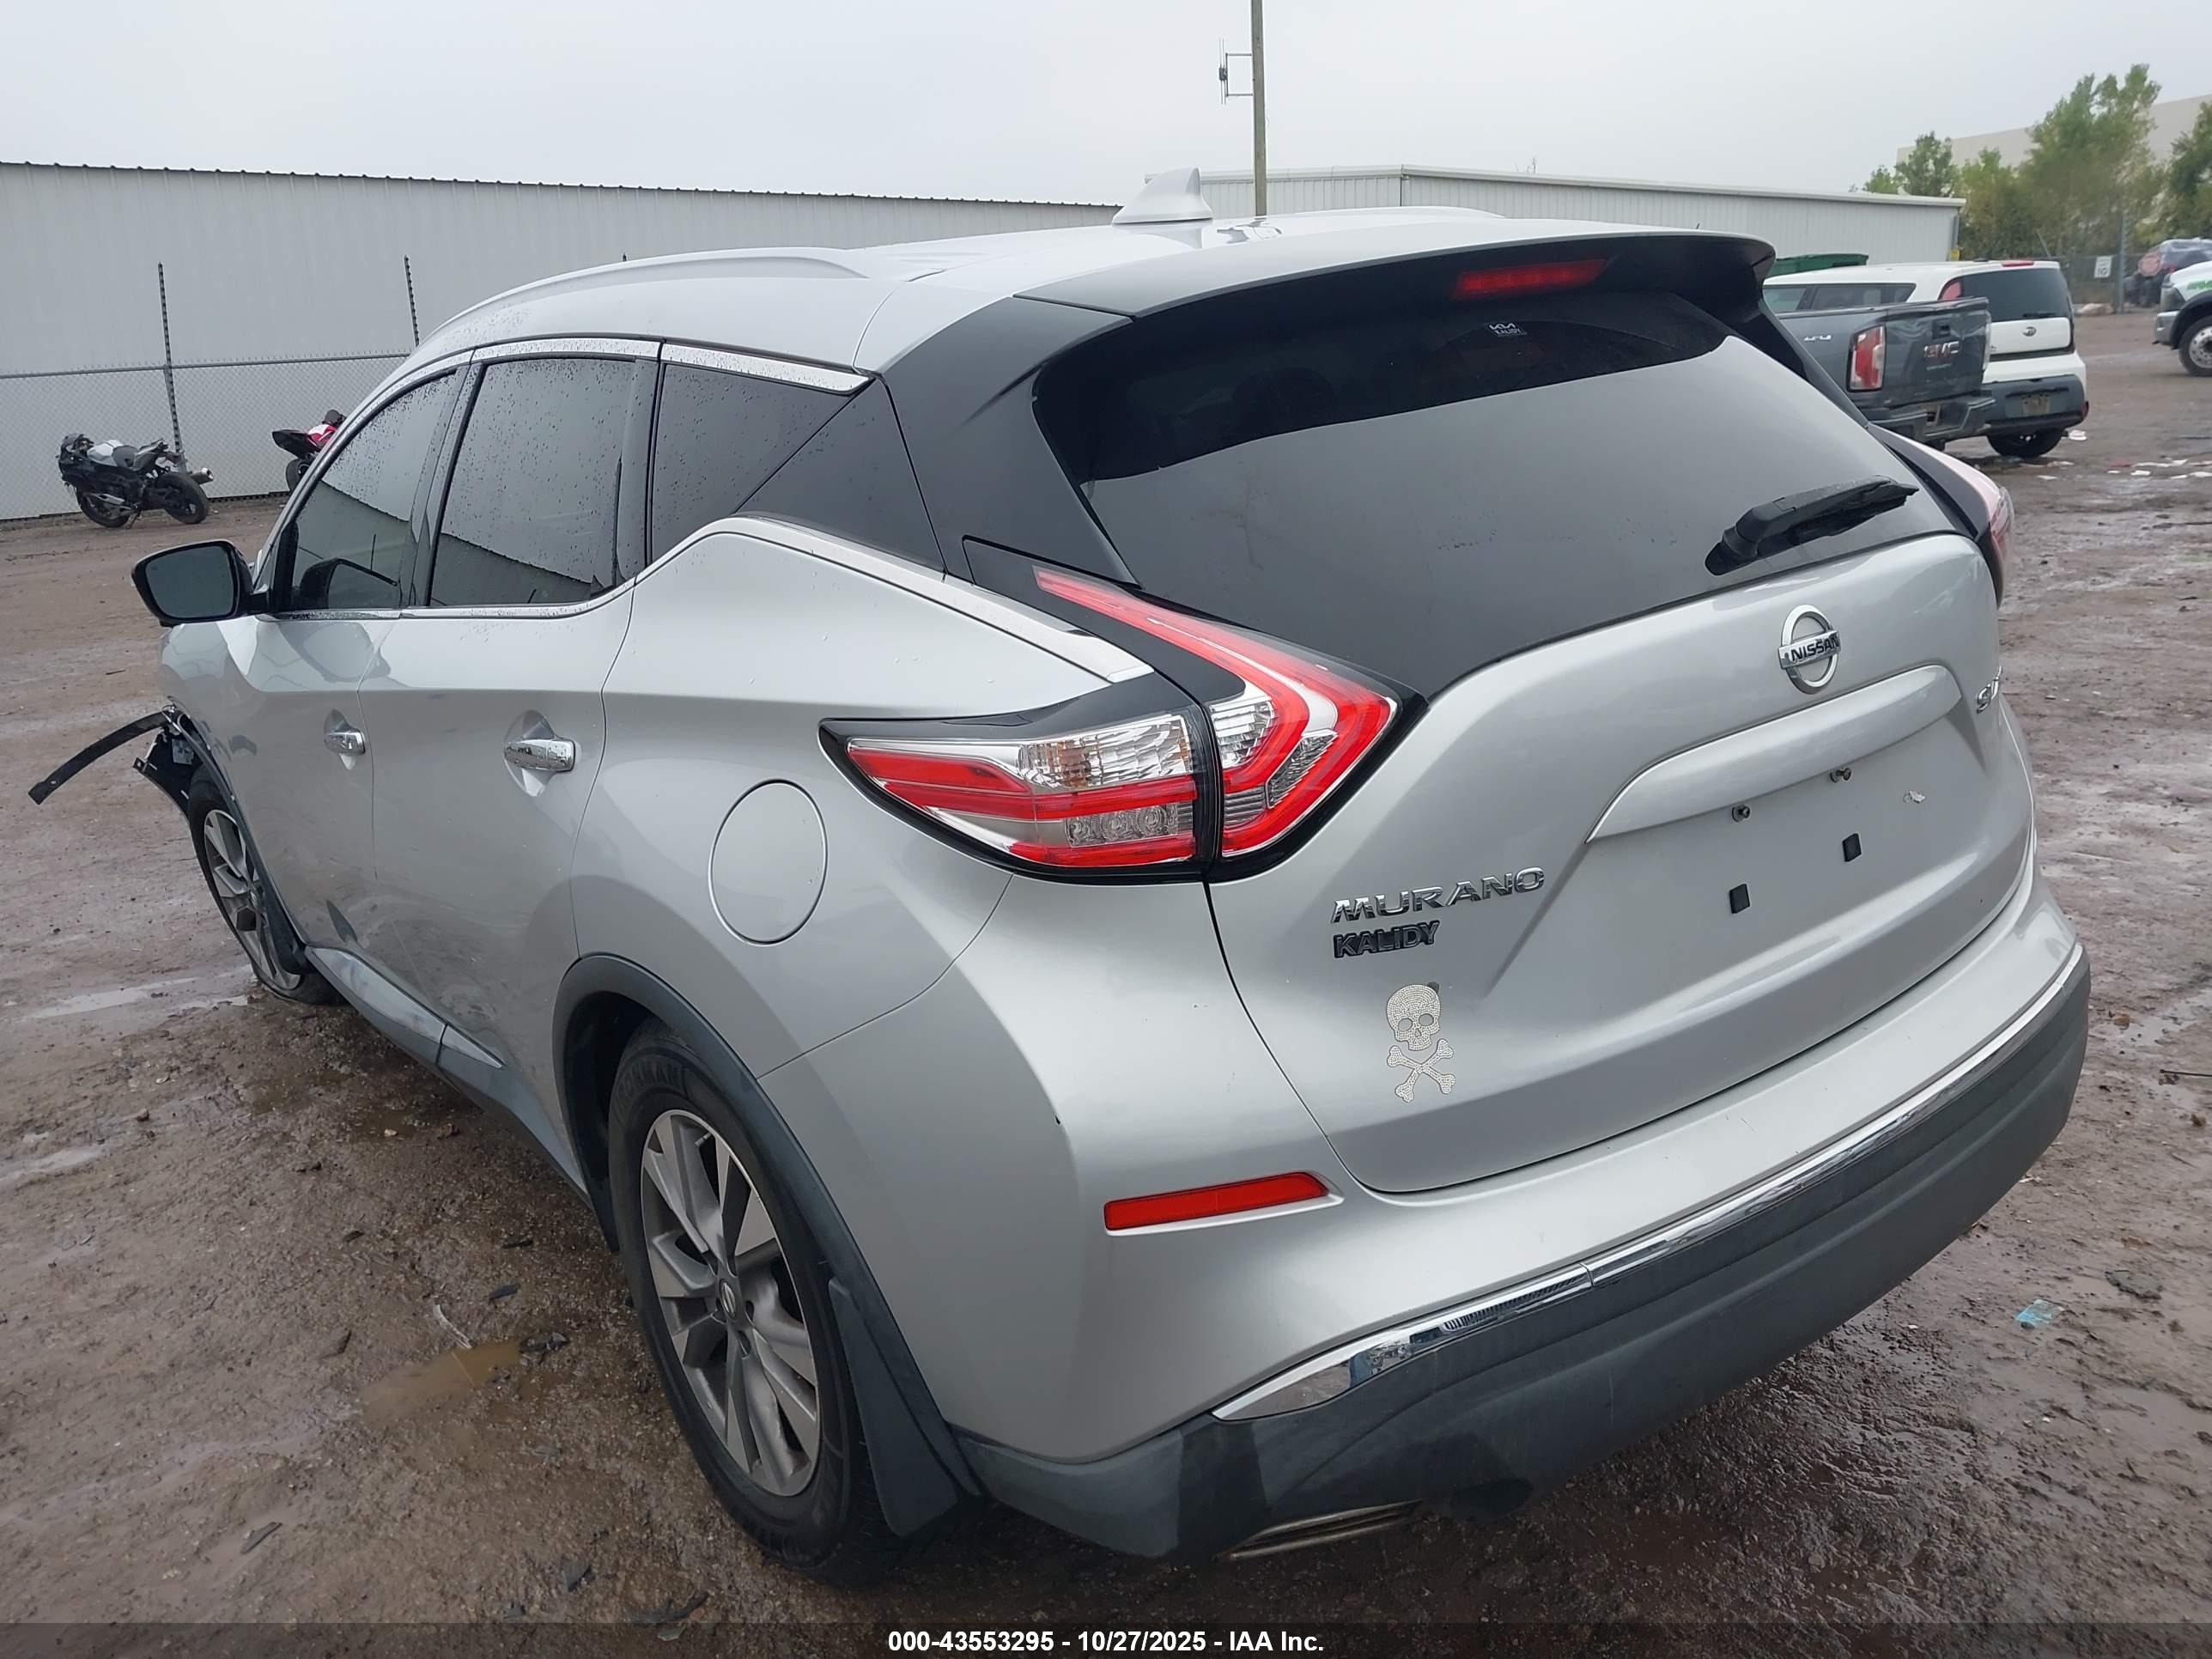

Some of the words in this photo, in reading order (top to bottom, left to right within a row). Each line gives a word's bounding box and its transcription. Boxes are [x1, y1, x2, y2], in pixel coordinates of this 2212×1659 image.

[1790, 632, 1839, 661] NISSAN
[1331, 866, 1546, 923] MURANO
[1333, 920, 1441, 958] KALIDY
